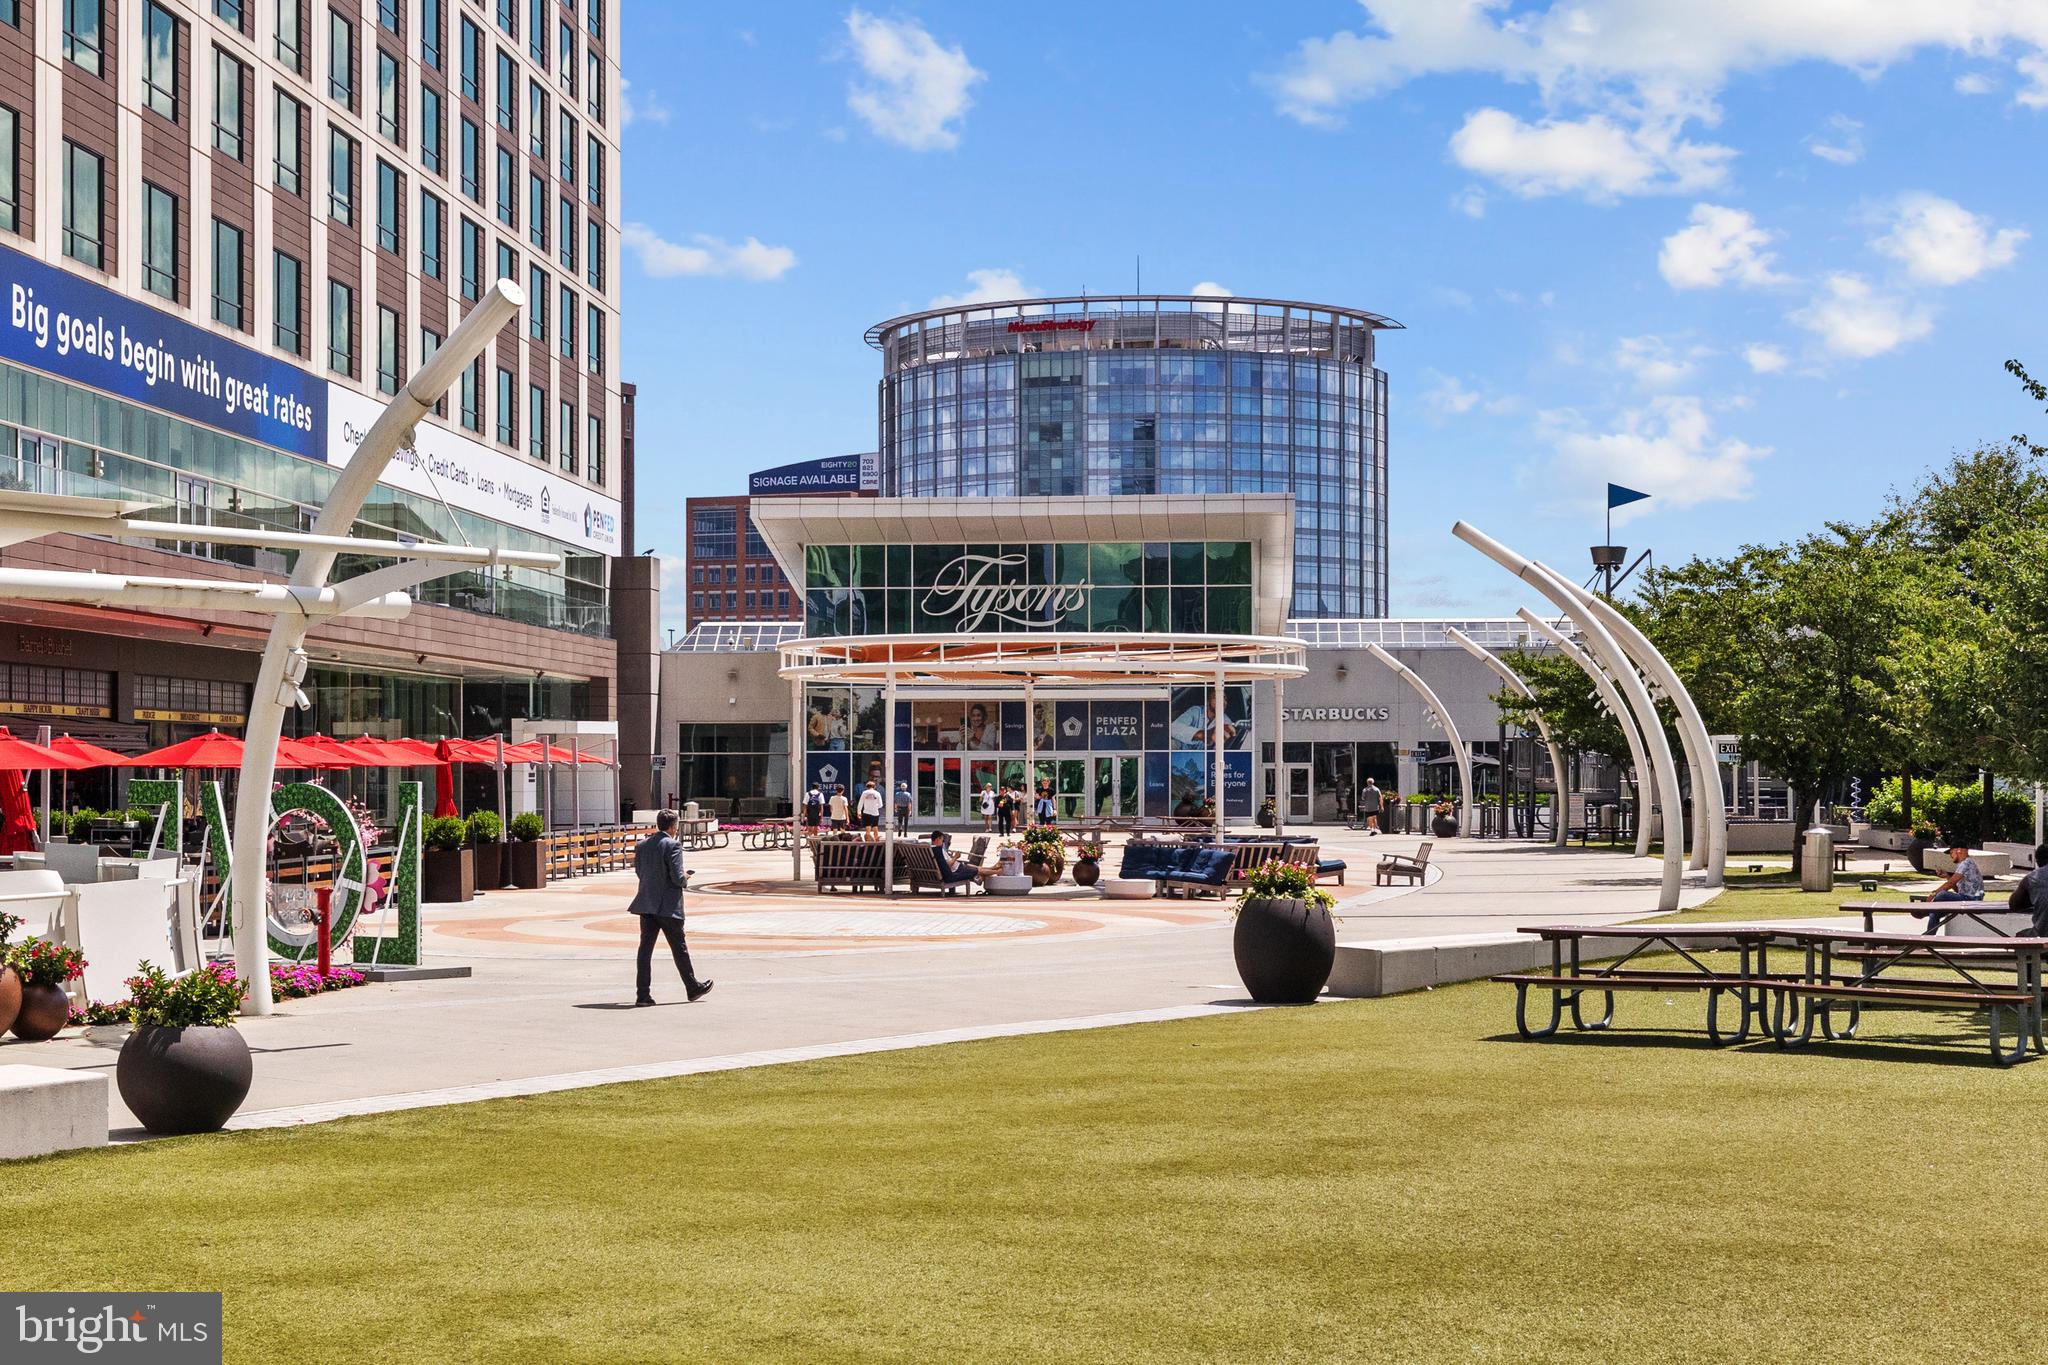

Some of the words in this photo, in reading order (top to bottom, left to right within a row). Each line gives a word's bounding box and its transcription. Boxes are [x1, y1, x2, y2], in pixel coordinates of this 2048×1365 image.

[12, 282, 49, 349] Big
[56, 311, 115, 361] goals
[120, 325, 176, 386] begin
[180, 353, 221, 399] with
[225, 374, 270, 414] great
[273, 392, 313, 432] rates
[428, 453, 449, 479] Credit
[450, 461, 469, 486] Cards
[477, 471, 495, 495] Loans
[503, 481, 533, 511] Mortgages
[752, 475, 798, 488] SIGNAGE
[799, 473, 857, 485] AVAILABLE
[921, 553, 1086, 634] Tysons
[1281, 707, 1389, 721] STARBUCKS
[1096, 716, 1138, 726] PENFED
[1096, 726, 1137, 736] PLAZA
[1720, 744, 1738, 753] EXIT
[1210, 762, 1232, 770] Gat
[1234, 771, 1245, 779] for
[1210, 780, 1247, 789] Eryone
